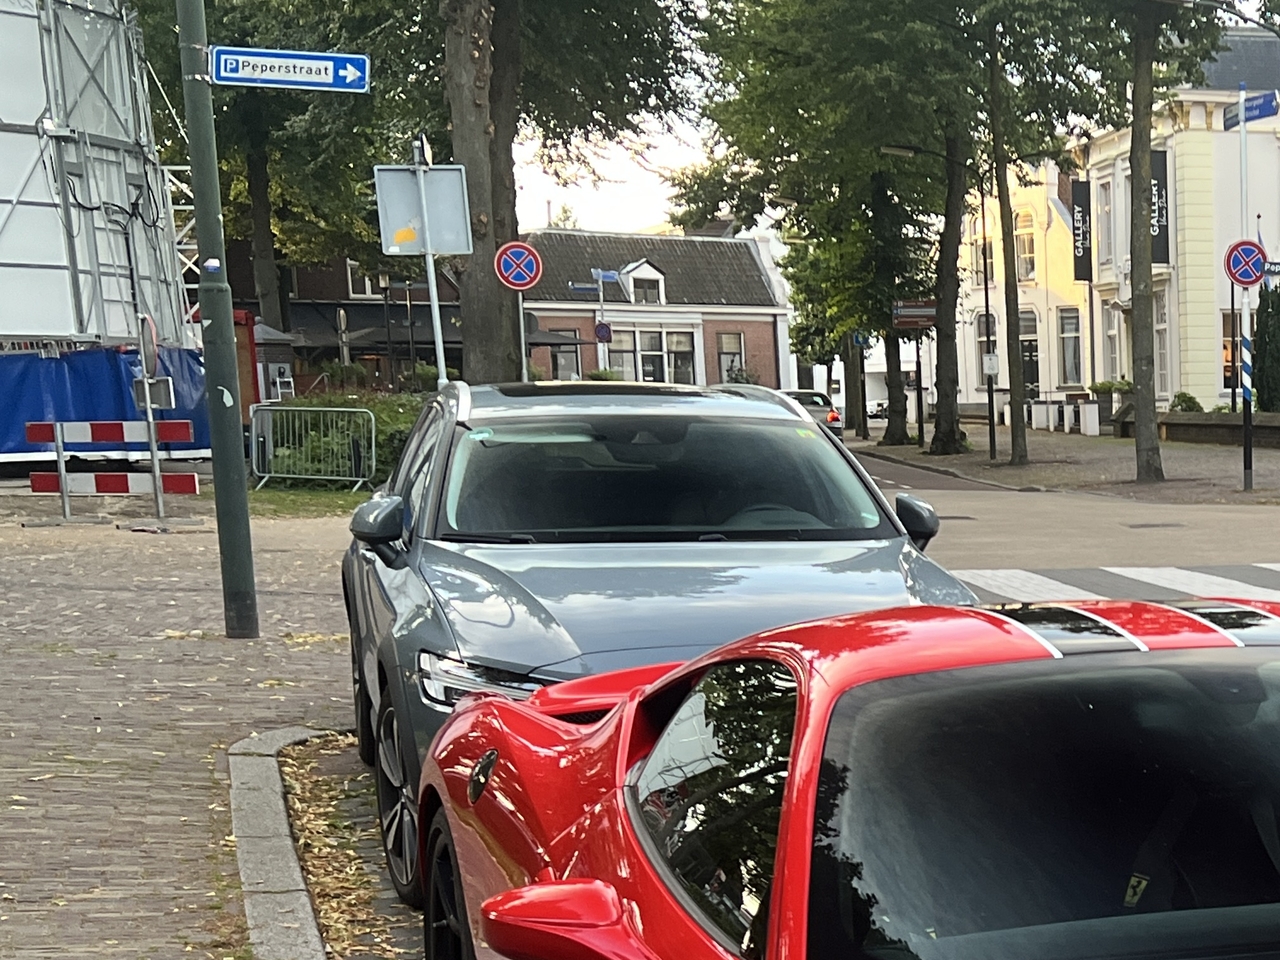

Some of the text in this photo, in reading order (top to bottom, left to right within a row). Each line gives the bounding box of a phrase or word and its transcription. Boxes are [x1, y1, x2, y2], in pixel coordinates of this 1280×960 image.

[242, 60, 329, 76] Peperstraat
[1073, 204, 1083, 257] GALLERY
[1150, 178, 1160, 236] GALLERY
